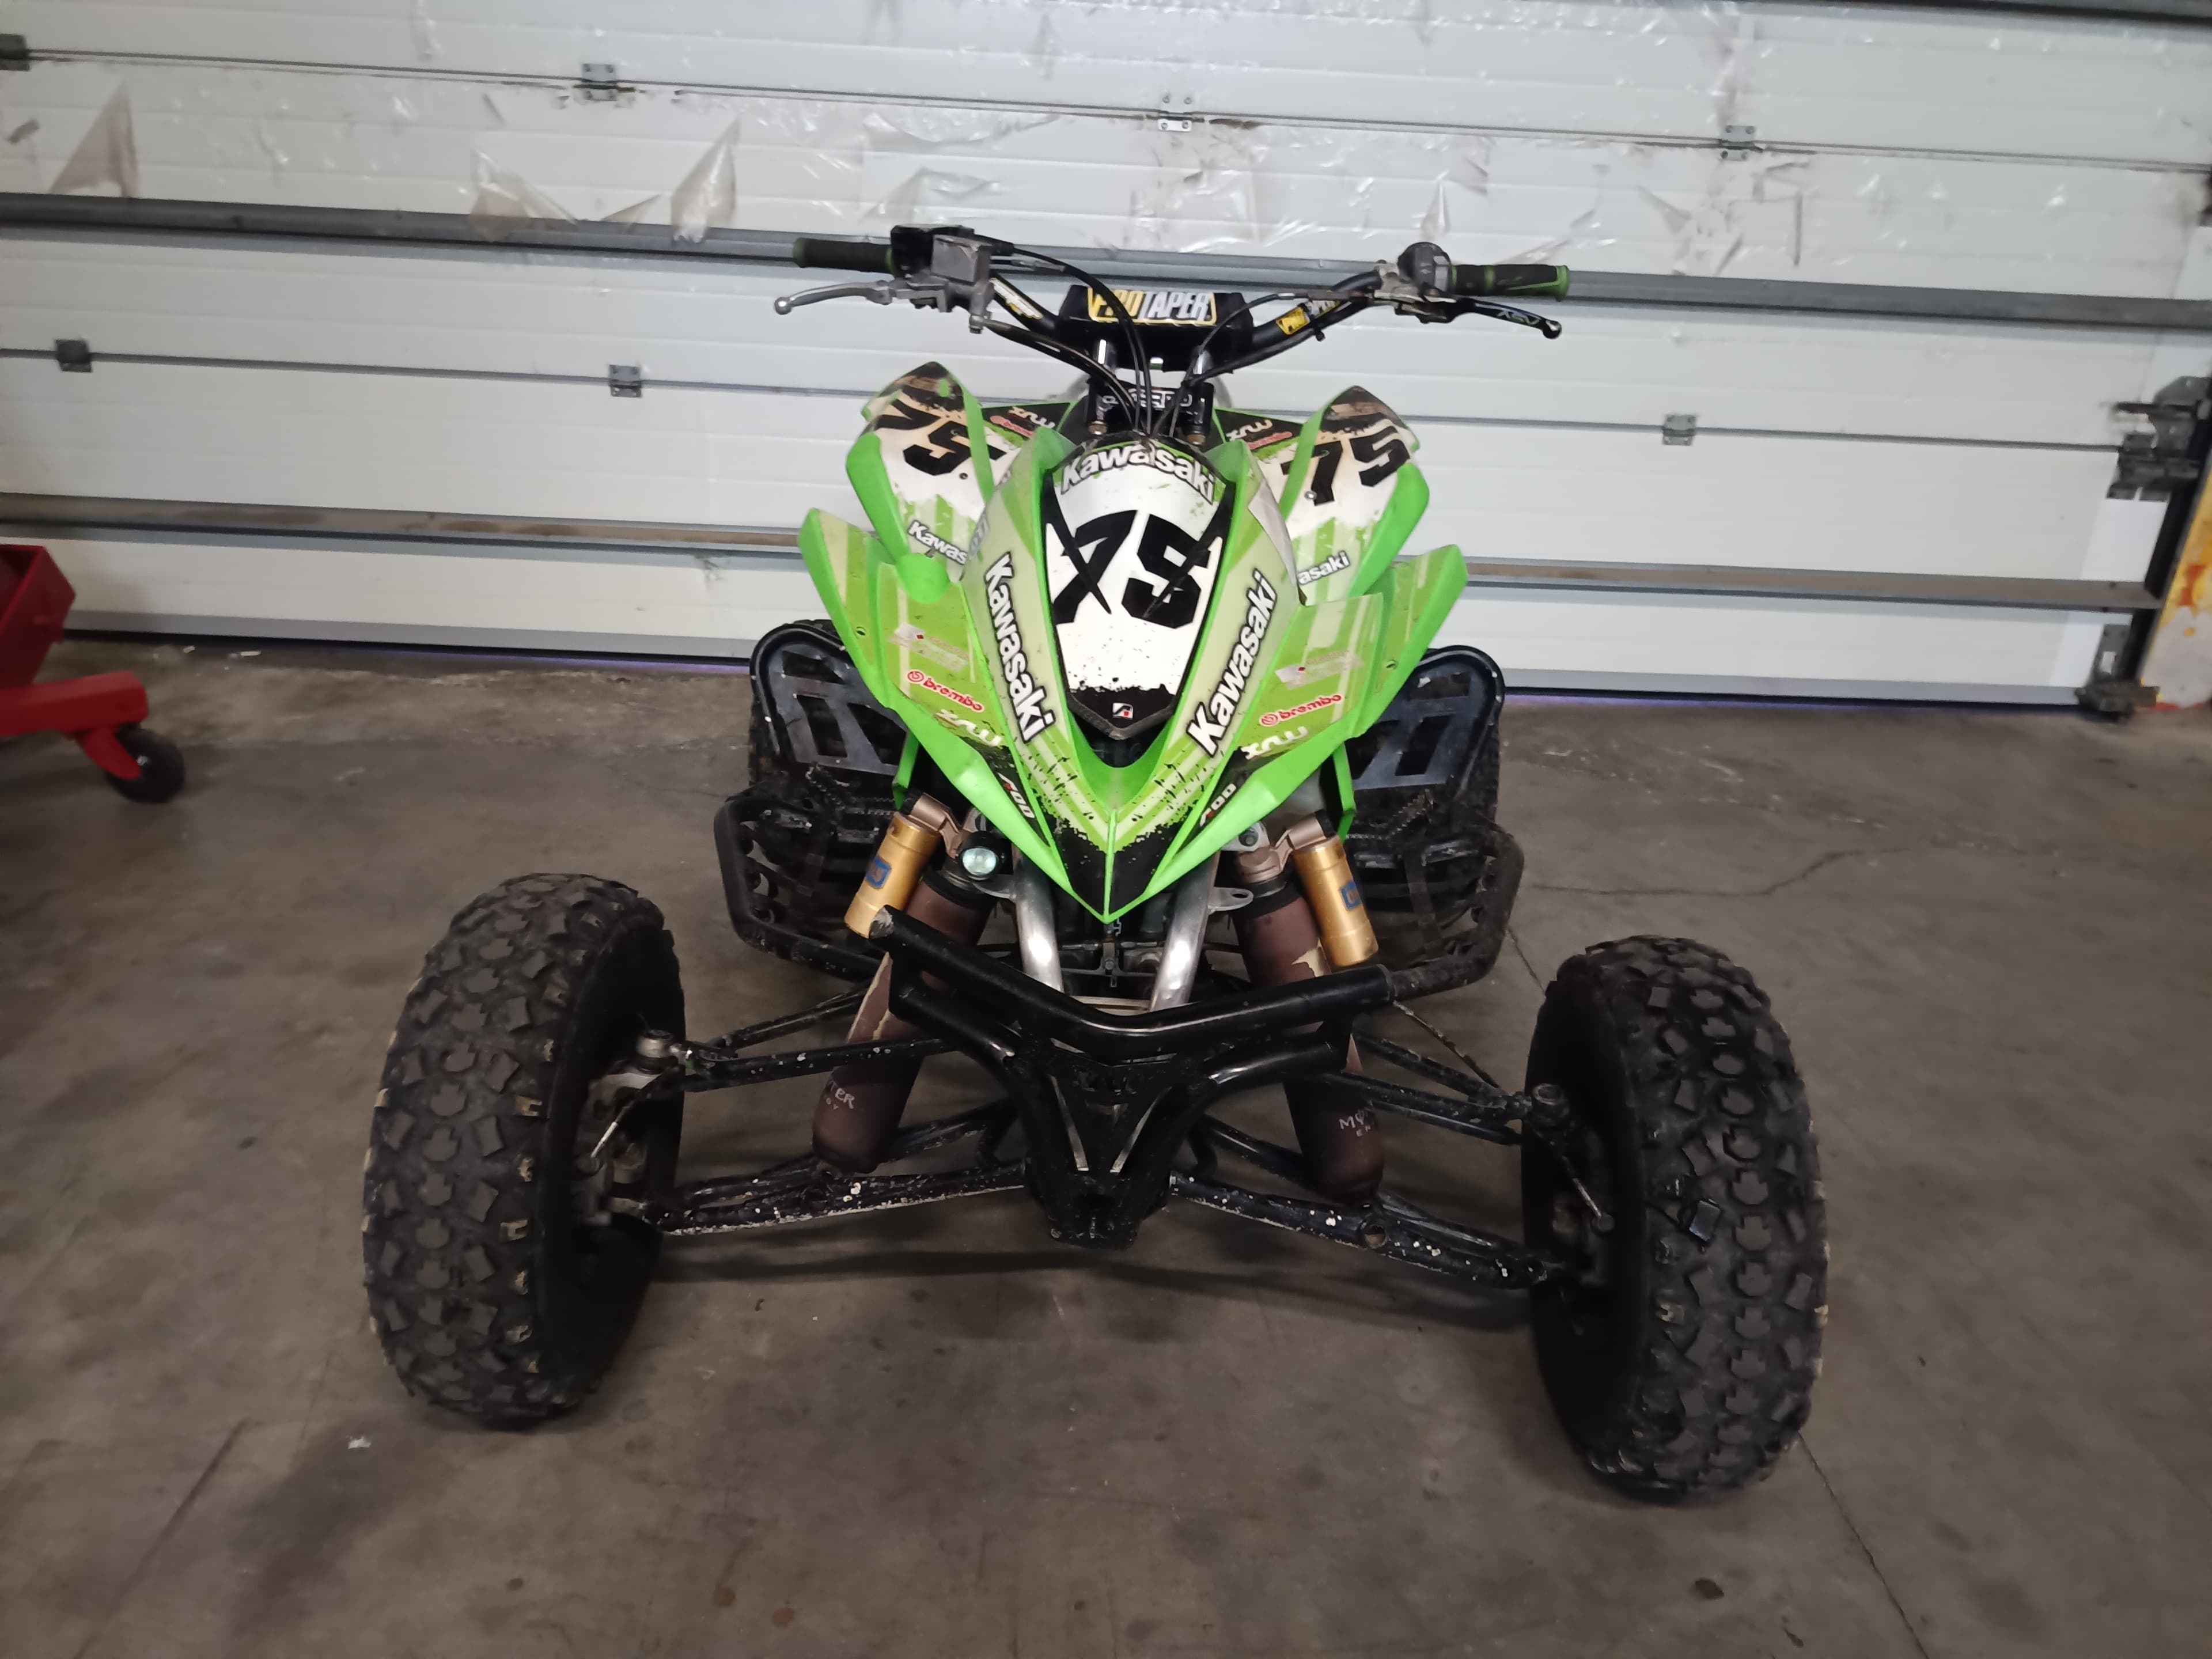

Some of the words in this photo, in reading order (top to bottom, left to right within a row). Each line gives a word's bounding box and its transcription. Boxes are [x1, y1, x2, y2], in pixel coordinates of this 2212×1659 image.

[1060, 445, 1214, 505] Kawasaki
[984, 551, 1055, 743] Kawasaki
[1187, 569, 1277, 757] Kawasaki
[923, 677, 983, 711] brembo
[1278, 694, 1342, 719] brembo
